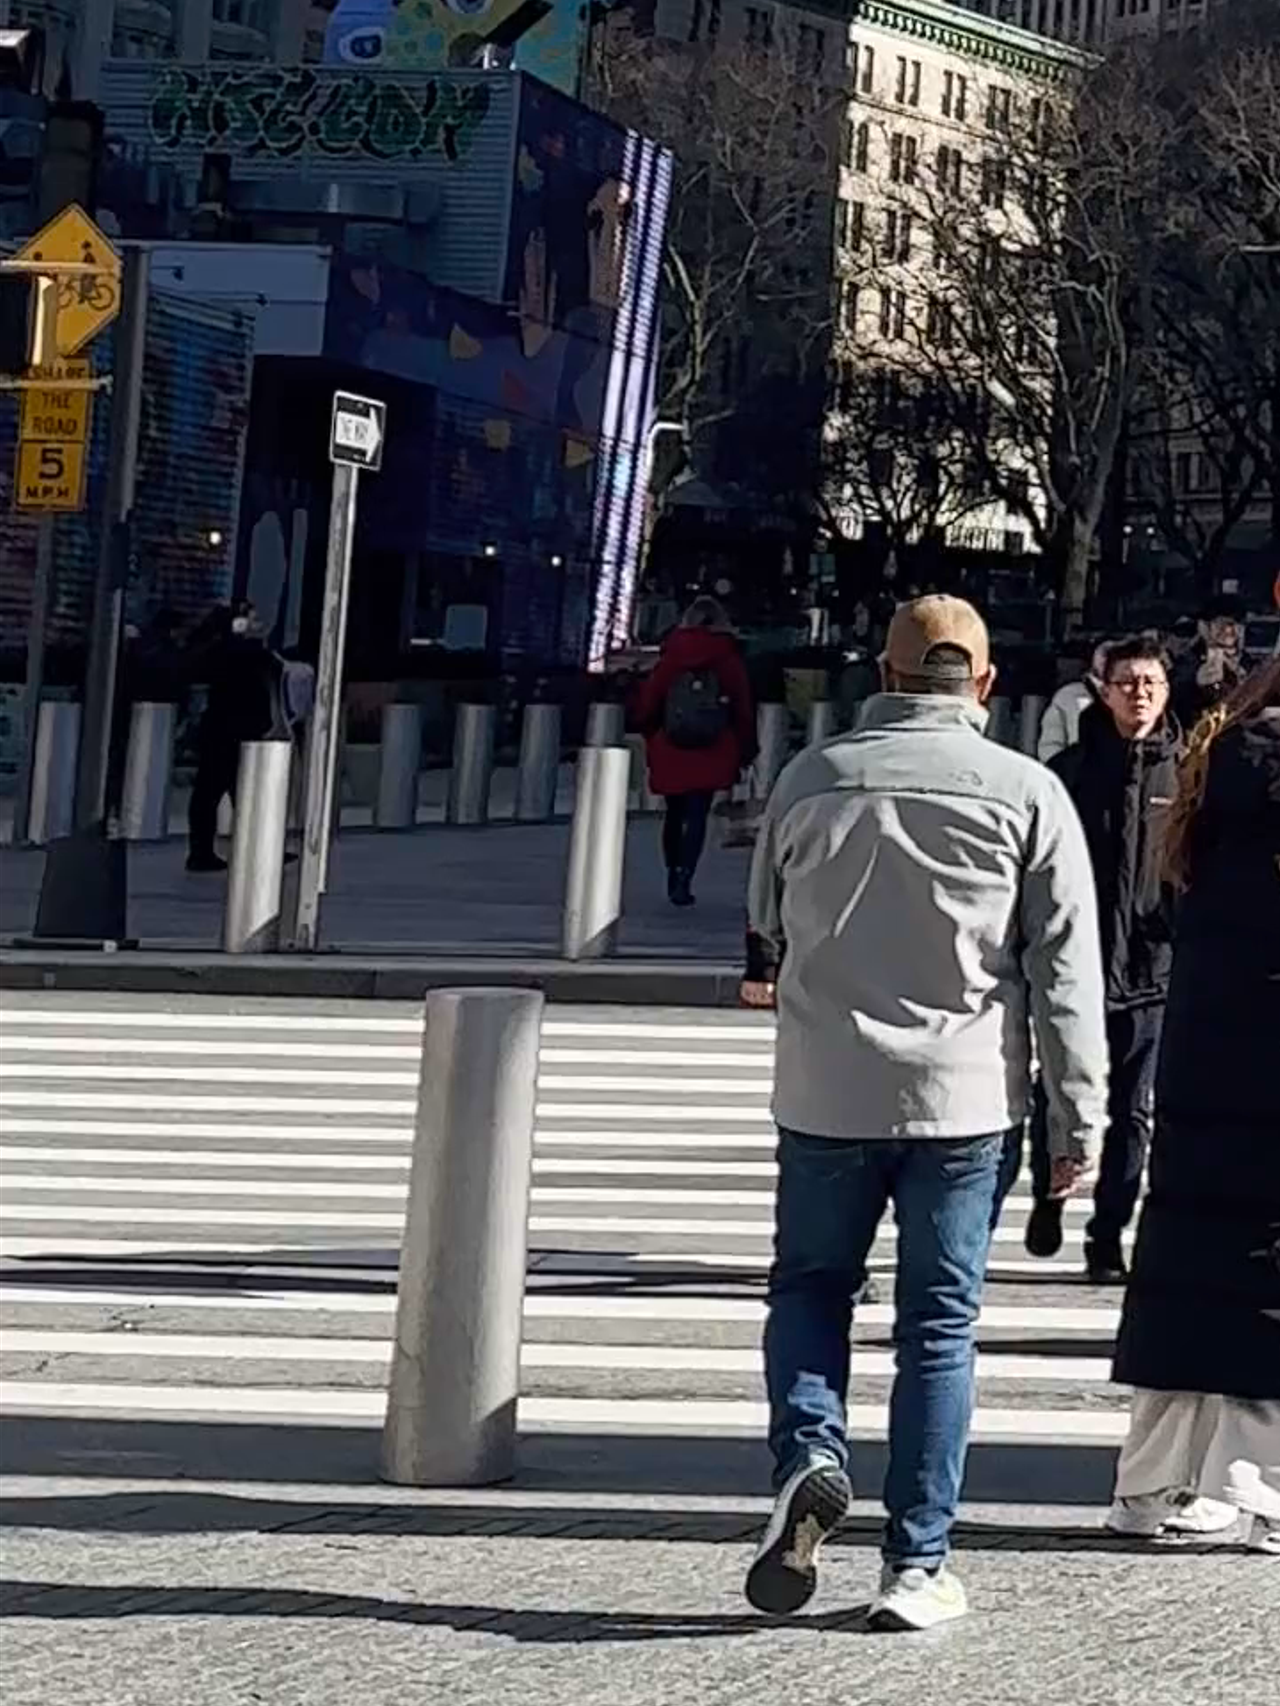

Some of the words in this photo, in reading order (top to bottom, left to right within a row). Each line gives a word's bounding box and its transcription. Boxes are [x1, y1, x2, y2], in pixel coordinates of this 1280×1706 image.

[42, 391, 71, 409] THE
[32, 416, 78, 435] ROAD
[39, 448, 64, 479] 5
